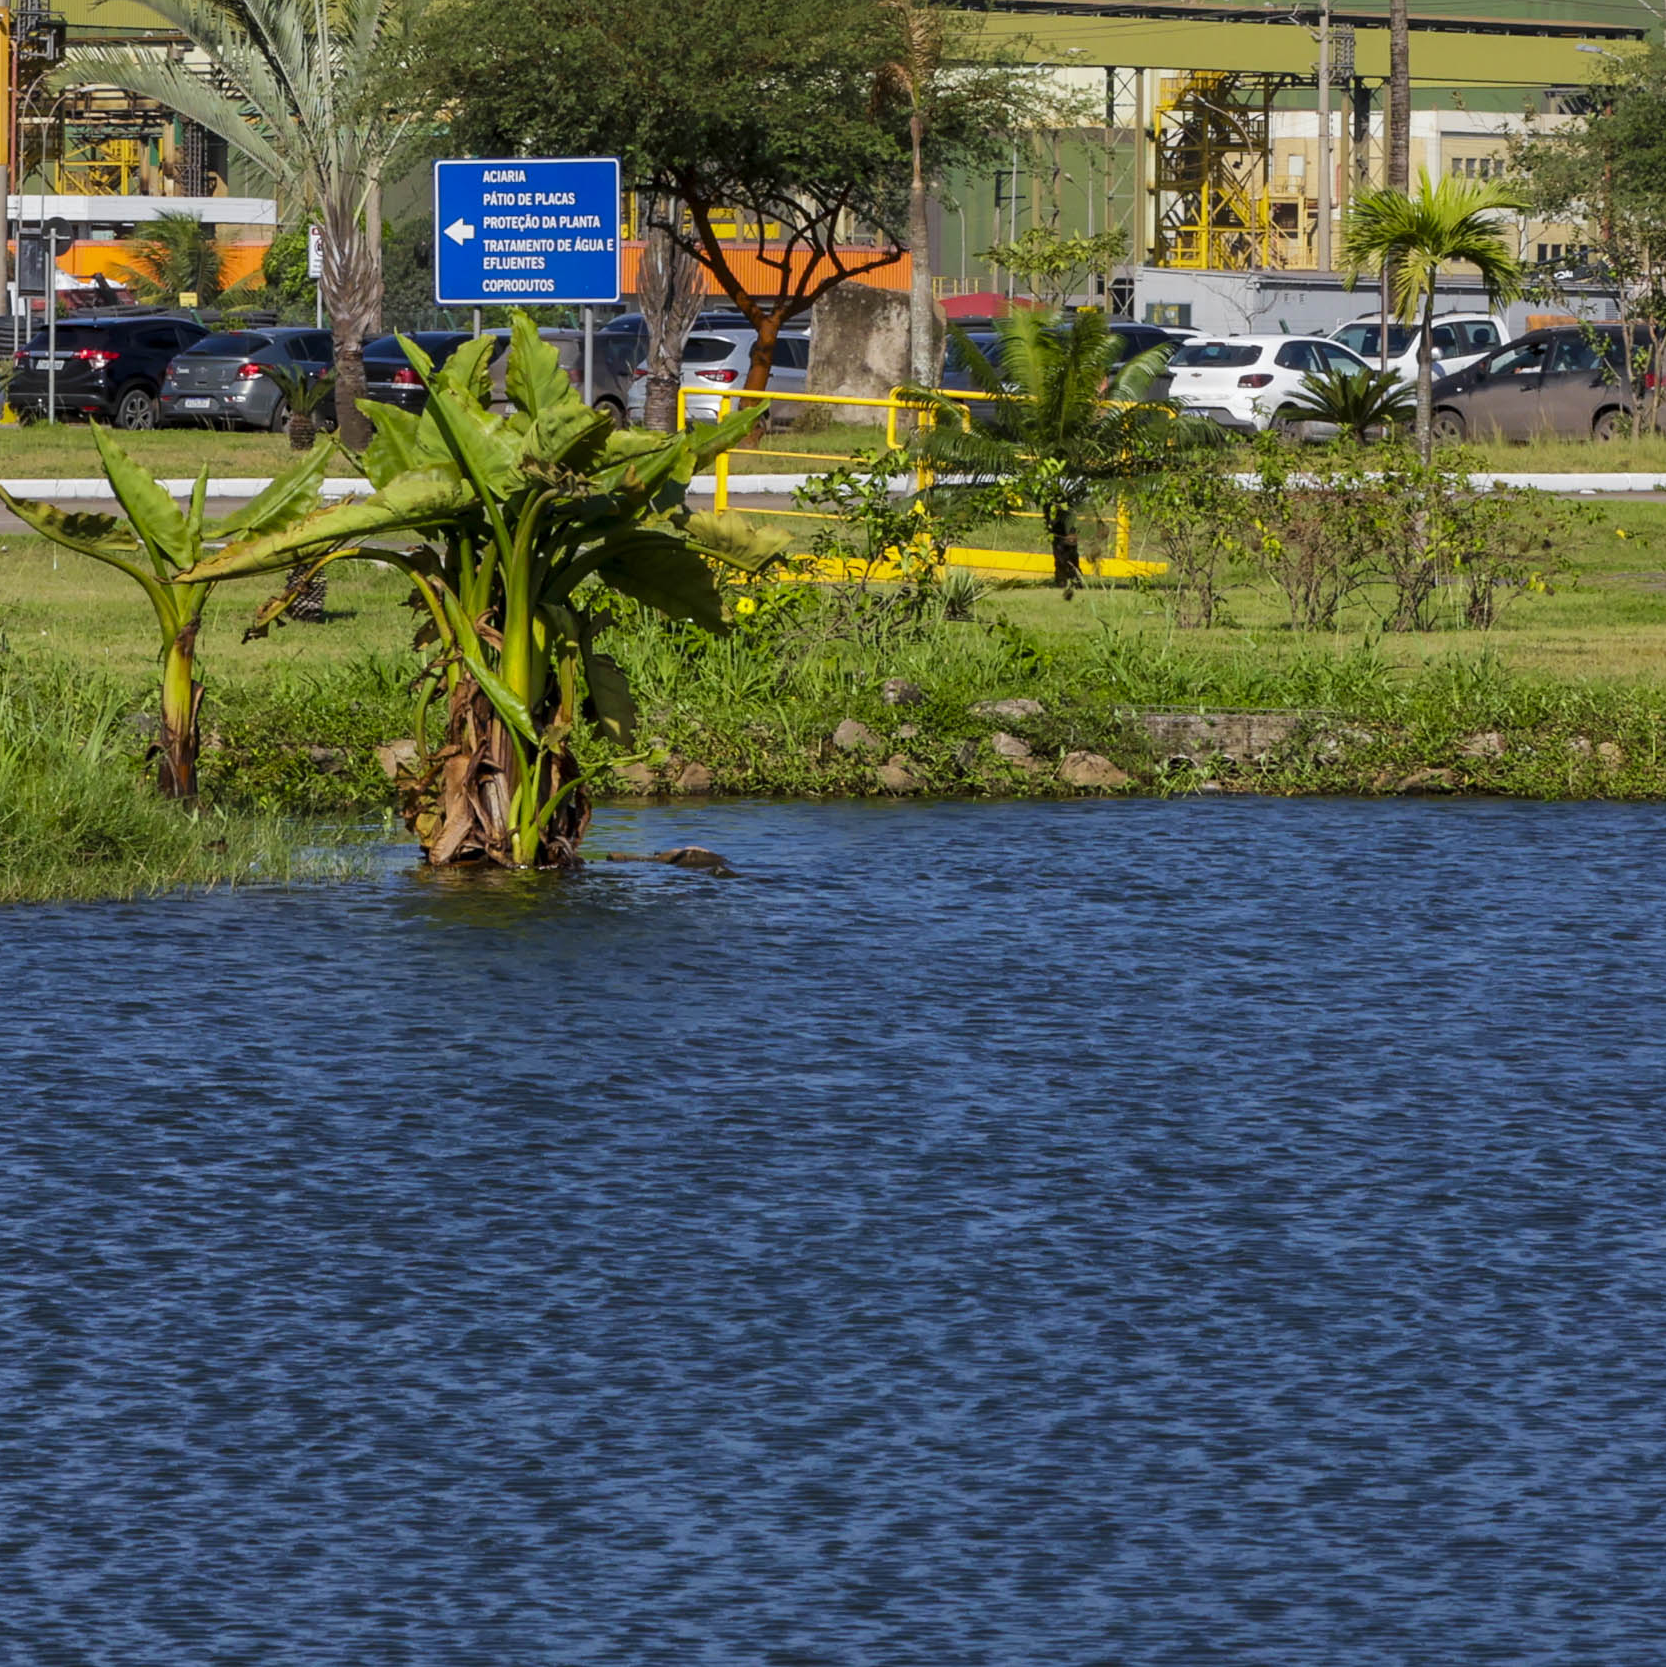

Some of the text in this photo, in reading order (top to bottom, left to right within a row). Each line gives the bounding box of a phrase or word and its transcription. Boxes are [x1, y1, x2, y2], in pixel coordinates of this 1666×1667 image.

[483, 170, 526, 182] ACIARIA
[483, 191, 575, 206] PÁTIO DE PLACAS
[483, 214, 600, 231] PROTEÇÃO DA PLANTA
[483, 237, 614, 252] TRATAMENTO DE ÁGUA E
[483, 256, 545, 269] EFLUENTES
[482, 279, 554, 292] COPRODUTOS
